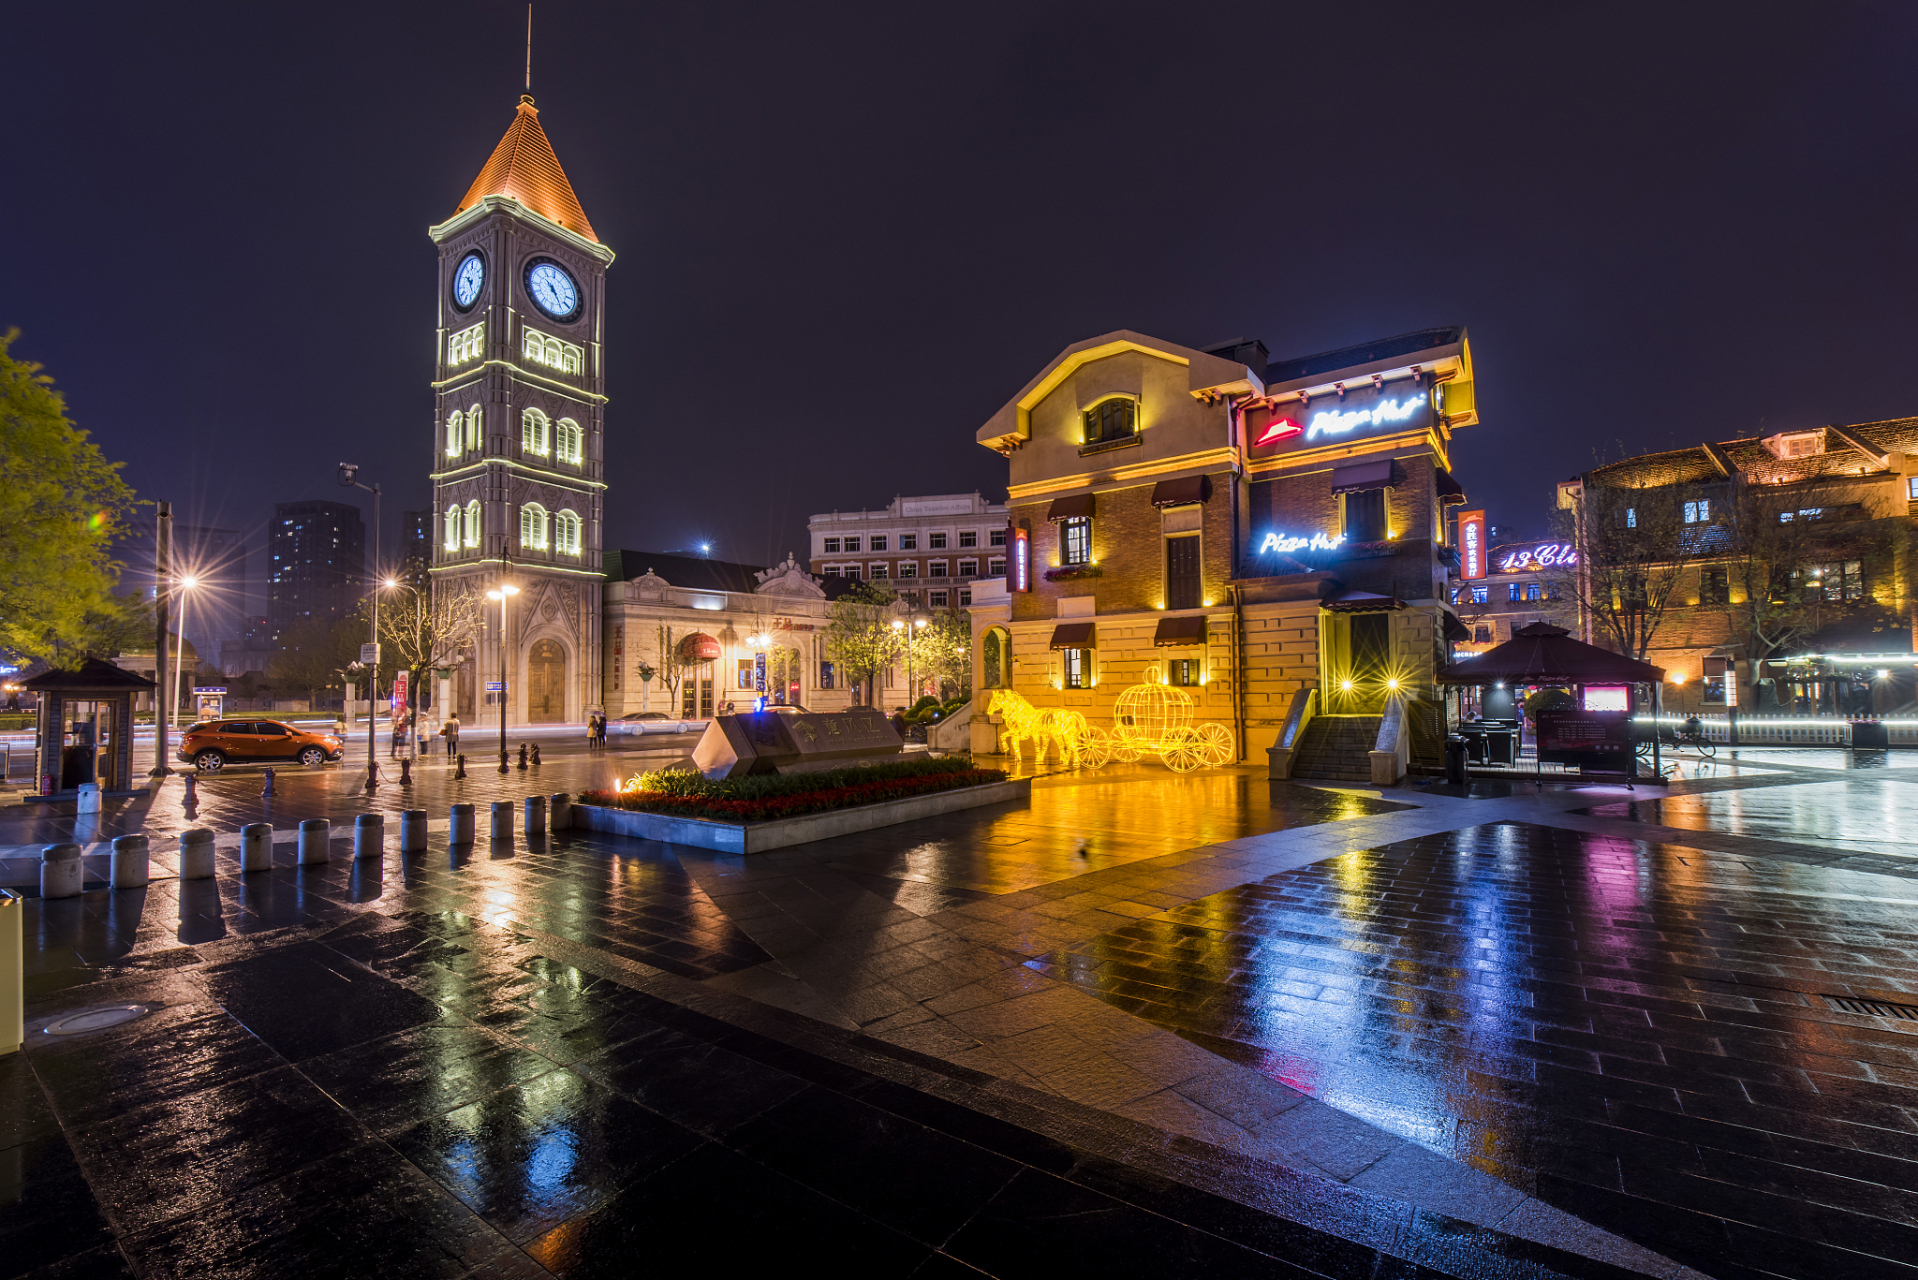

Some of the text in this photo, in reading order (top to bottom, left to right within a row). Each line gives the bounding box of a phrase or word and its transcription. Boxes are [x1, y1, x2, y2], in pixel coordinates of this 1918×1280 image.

[1307, 396, 1425, 440] Pizza Hut
[951, 502, 971, 510] Affairs
[1260, 532, 1347, 554] Pizza Hut
[1501, 551, 1531, 569] 13
